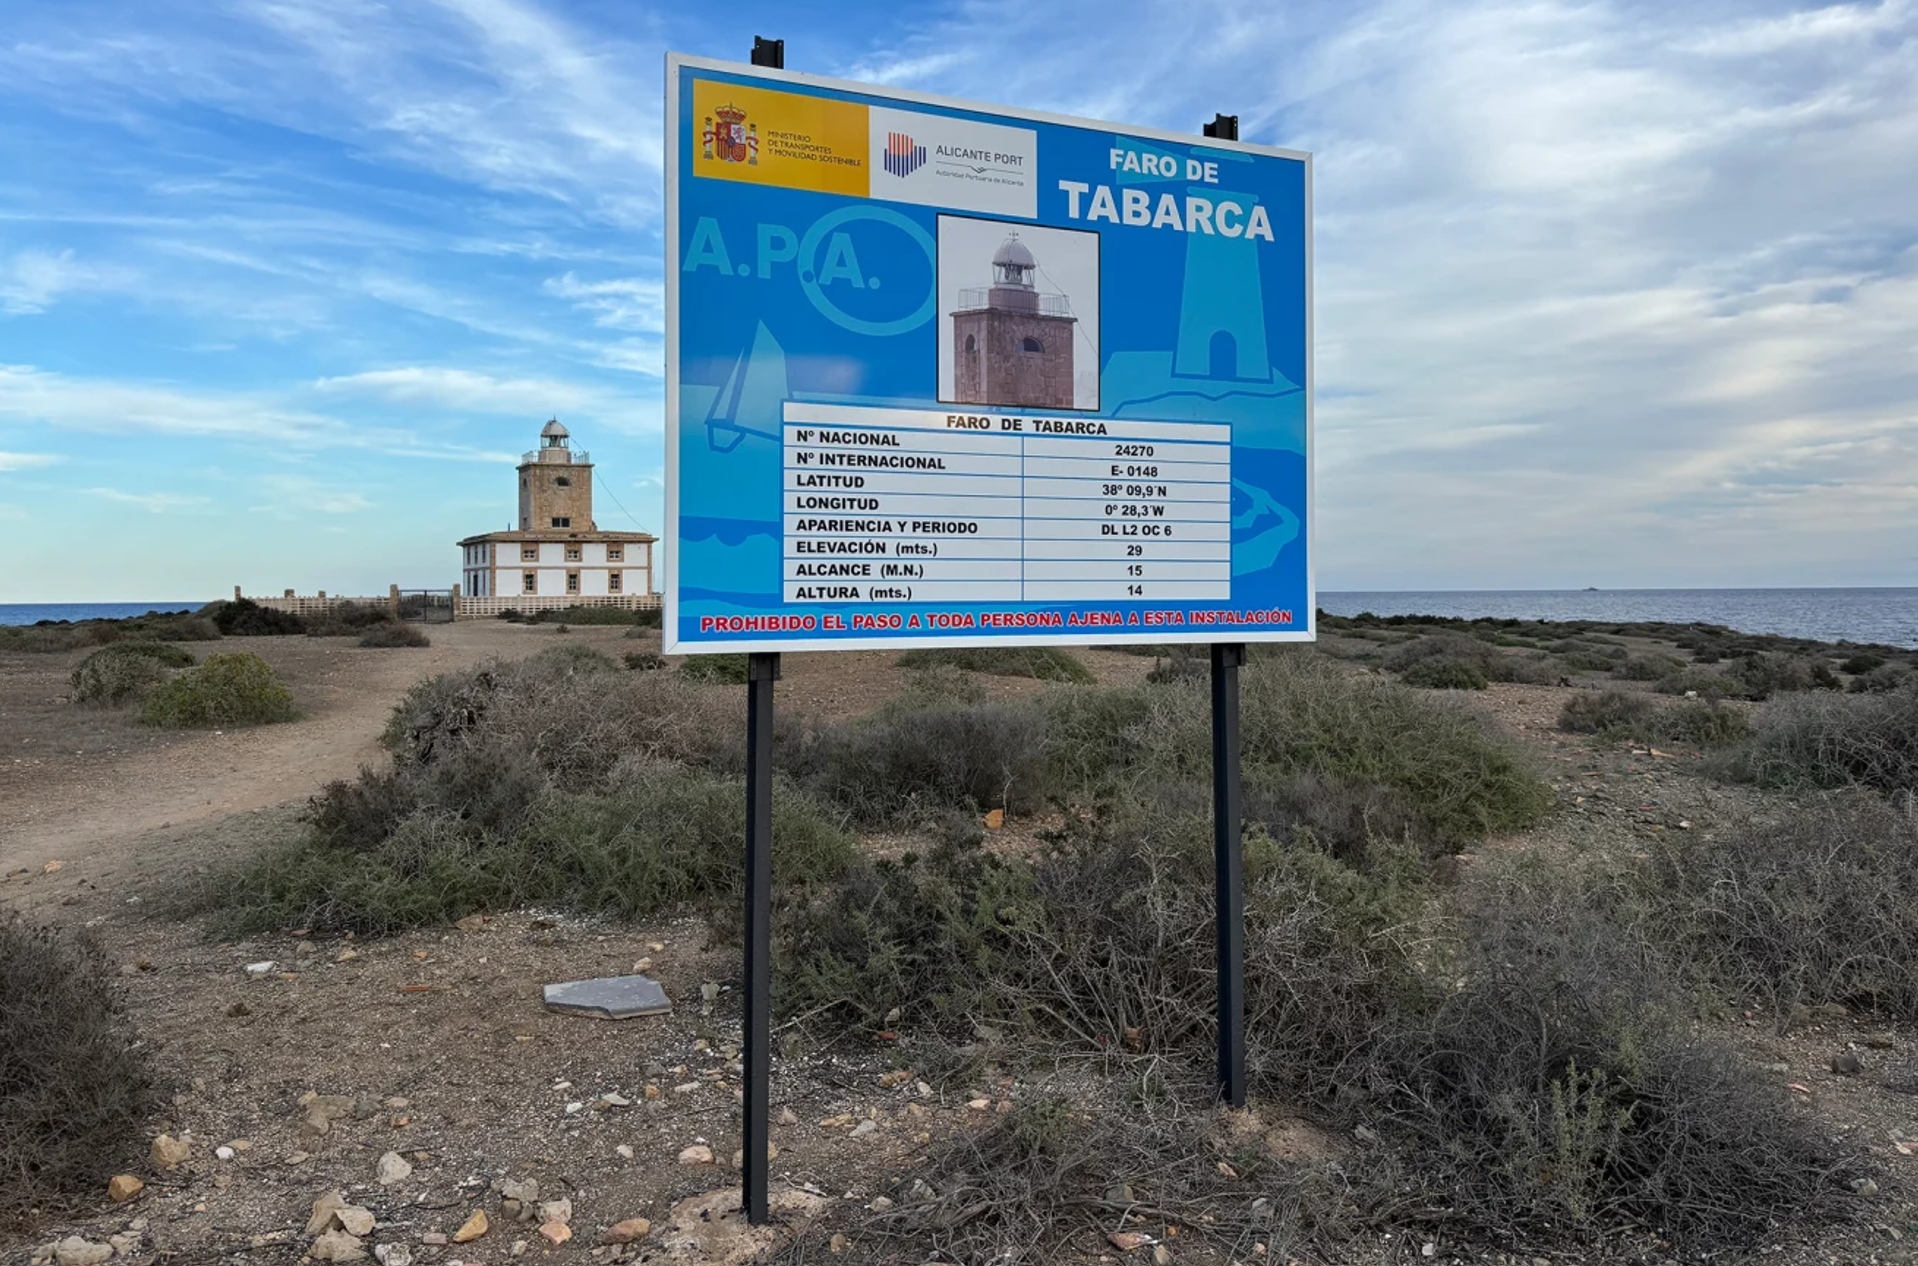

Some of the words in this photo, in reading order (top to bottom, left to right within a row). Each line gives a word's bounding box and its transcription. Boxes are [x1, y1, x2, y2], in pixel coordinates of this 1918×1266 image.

[767, 130, 811, 142] MINISTERIO
[780, 140, 832, 154] TRANSPORTES
[774, 149, 817, 161] MOVILIDAD
[819, 155, 862, 167] SOSTENIBLE
[936, 144, 991, 162] ALICANTE
[994, 152, 1024, 166] PORT
[1110, 148, 1177, 177] FARO
[1186, 159, 1219, 184] DE
[1058, 179, 1275, 242] TABARCA
[946, 415, 991, 430] FARO
[1001, 418, 1023, 431] DE
[1032, 419, 1108, 436] TABARCA
[819, 432, 900, 447] NACIONAL
[1114, 445, 1154, 457] 24270
[819, 453, 946, 470] INTERNACIONAL
[1127, 466, 1158, 478] 0148
[796, 474, 865, 489] LATITUD
[796, 497, 879, 511] LONGITUD
[796, 519, 892, 533] APARIENCIA
[897, 521, 908, 533] Y
[912, 522, 978, 535] PERIODO
[1101, 524, 1118, 537] DL
[1122, 525, 1138, 537] L2
[1141, 525, 1161, 537] OC
[1163, 525, 1172, 537] 6
[796, 539, 887, 555] ELEVACIÓN
[895, 542, 938, 557] (mts.)
[1126, 545, 1143, 557] 29
[796, 564, 871, 577] ALCANCE
[880, 564, 924, 579] (M.N.)
[1126, 565, 1143, 577] 15
[796, 587, 860, 599] ALTURA
[869, 587, 912, 601] (mts.)
[1126, 585, 1143, 597] 14
[700, 615, 816, 632] PROHIBIDO
[822, 614, 846, 630] EL
[853, 613, 902, 629] PASO
[908, 613, 921, 629] A
[926, 612, 975, 628] TODA
[980, 612, 1063, 627] PERSONA
[1067, 611, 1124, 627] AJENA
[1127, 610, 1139, 626] A
[1144, 609, 1185, 625] ESTA
[1189, 606, 1293, 625] INSTALACIÓN
